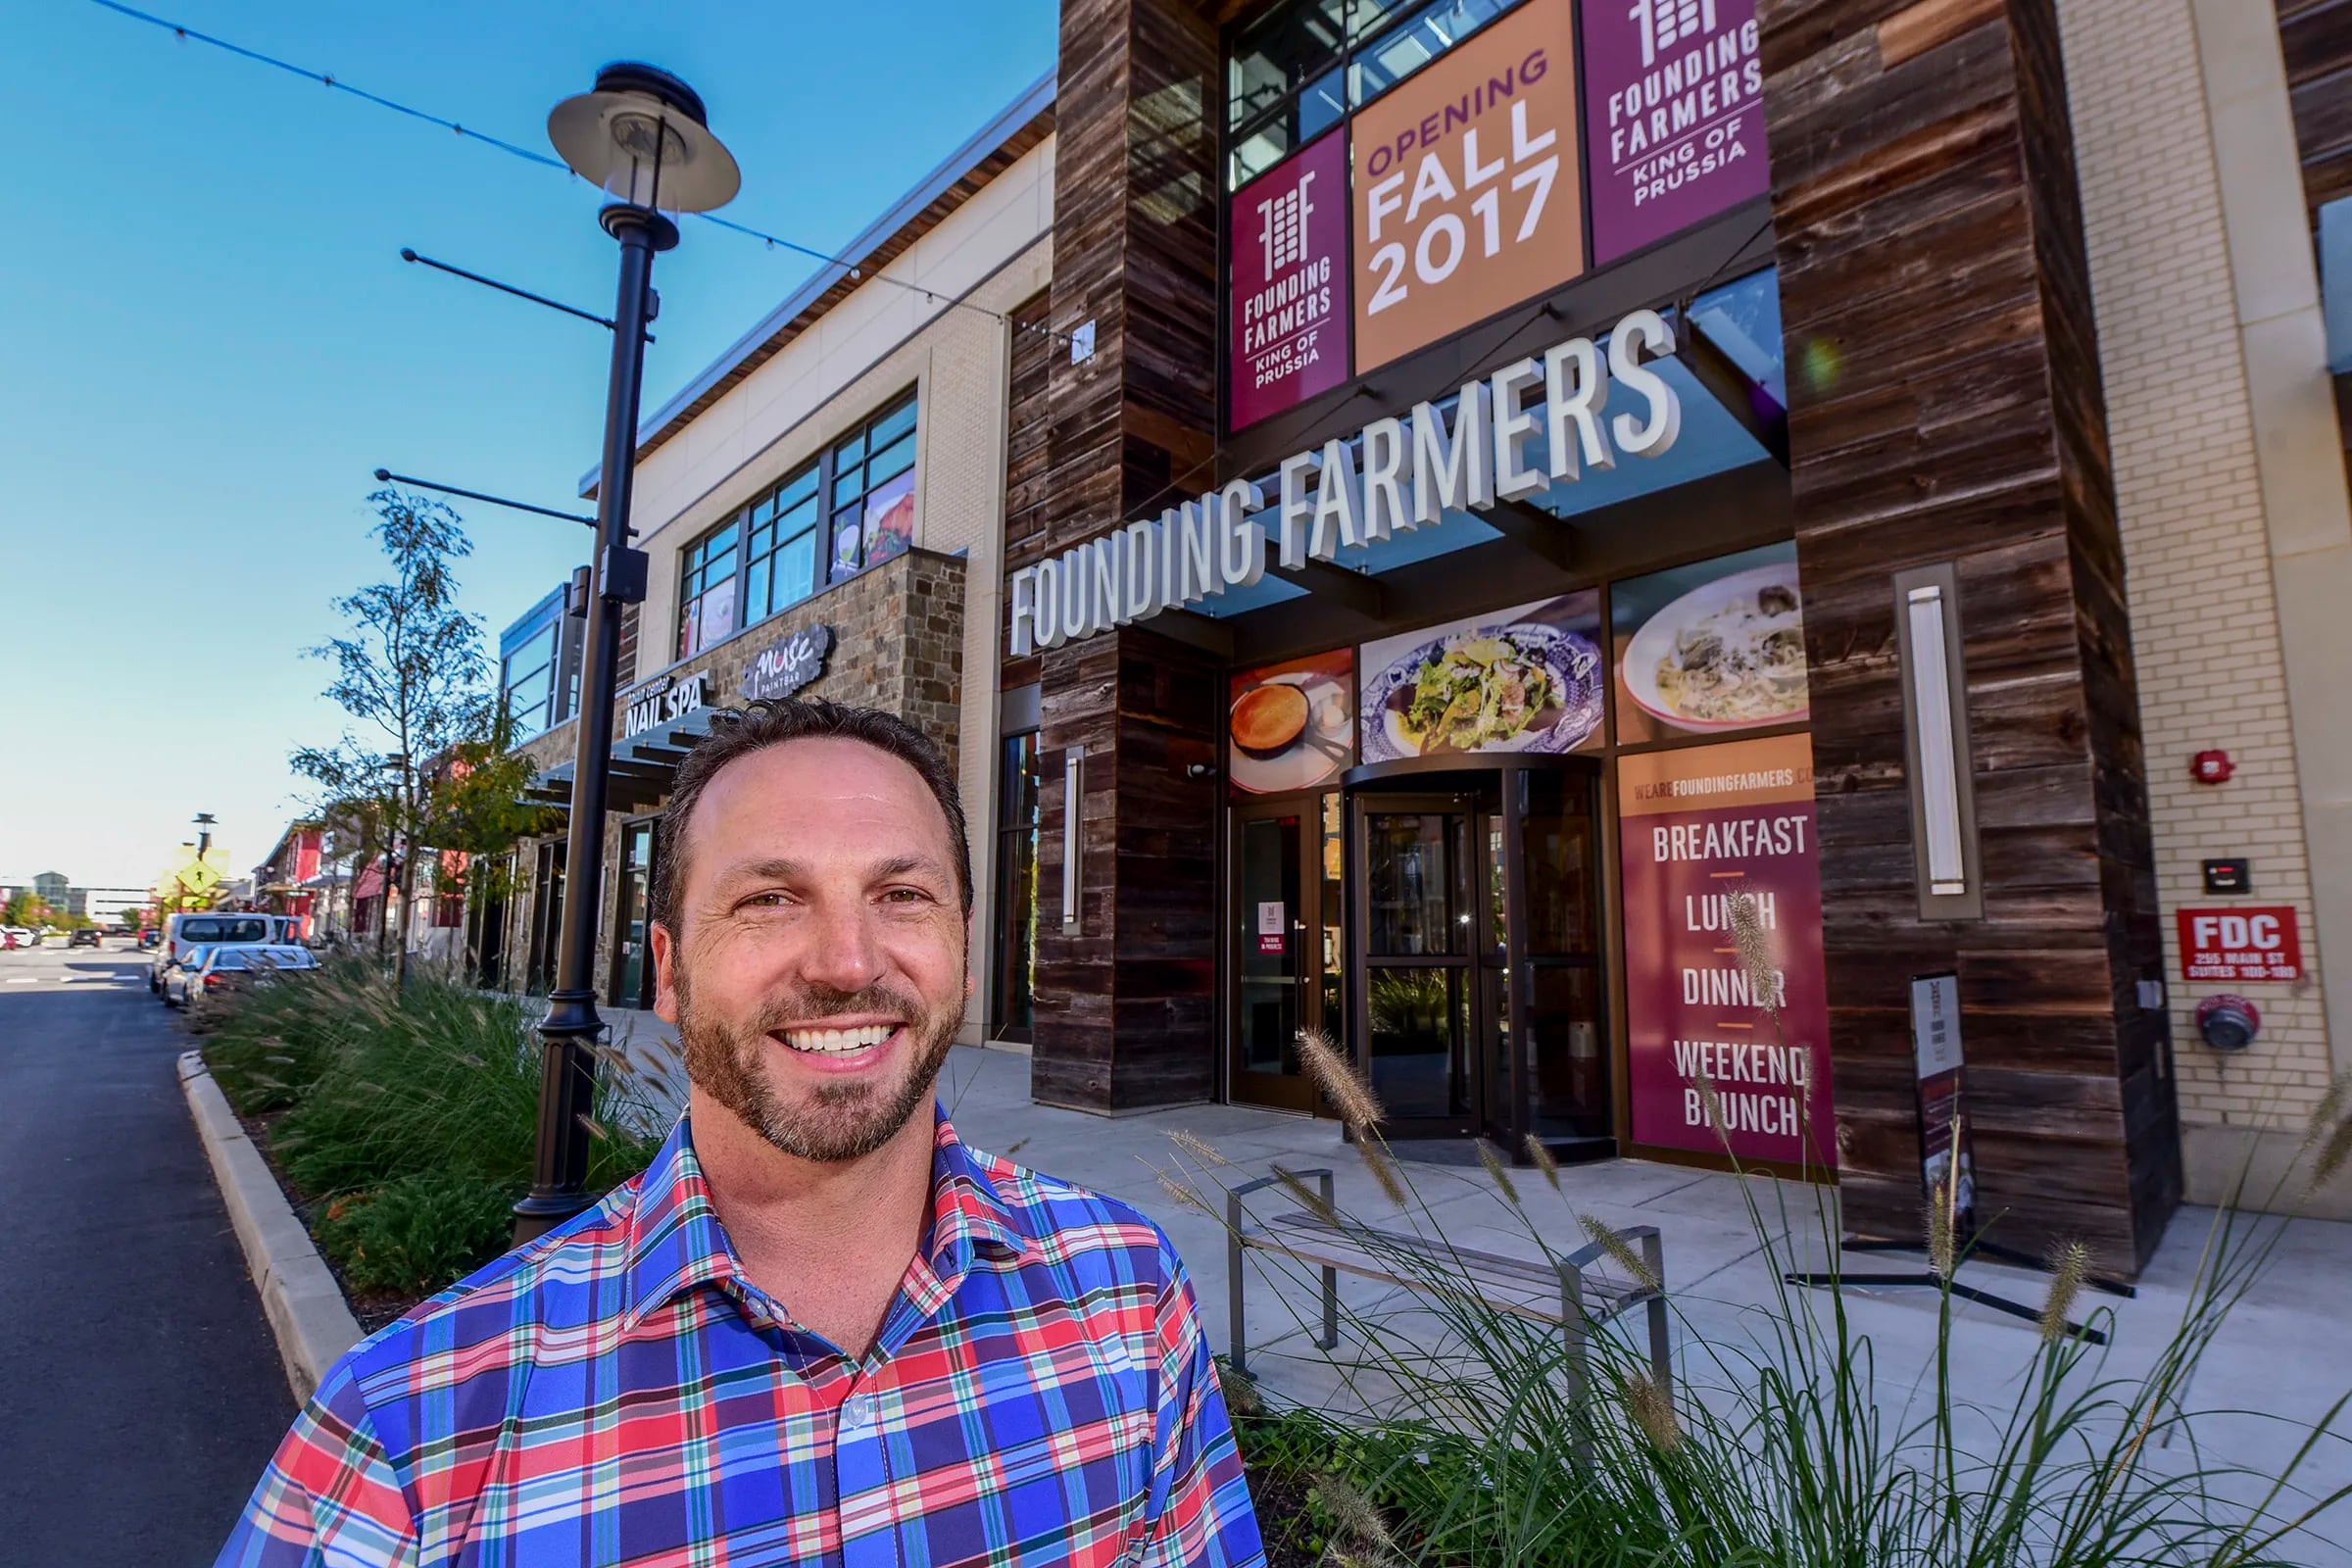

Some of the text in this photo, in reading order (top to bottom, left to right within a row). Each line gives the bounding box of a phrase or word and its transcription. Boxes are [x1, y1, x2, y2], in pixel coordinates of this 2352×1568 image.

[1608, 18, 1760, 127] FOUNDING
[1367, 48, 1548, 177] OPENING
[1610, 58, 1763, 165] FARMERS
[1369, 99, 1557, 243] FALL
[1633, 117, 1742, 186] KING OF
[1634, 140, 1746, 207] PRUSSIA
[1367, 154, 1560, 316] 2017
[1245, 256, 1330, 324] FOUNDING
[1245, 286, 1331, 354] FARMERS
[1255, 330, 1318, 372] KING OF
[1255, 348, 1319, 389] PRUSSIA
[1010, 309, 1681, 657] FOUNDING FARMERS
[625, 677, 702, 739] NAIL SPA
[1653, 815, 1808, 862] BREAKFAST
[1686, 892, 1776, 931] LUNH
[2192, 914, 2281, 950] FDC
[1673, 1040, 1806, 1086] WEEKEND
